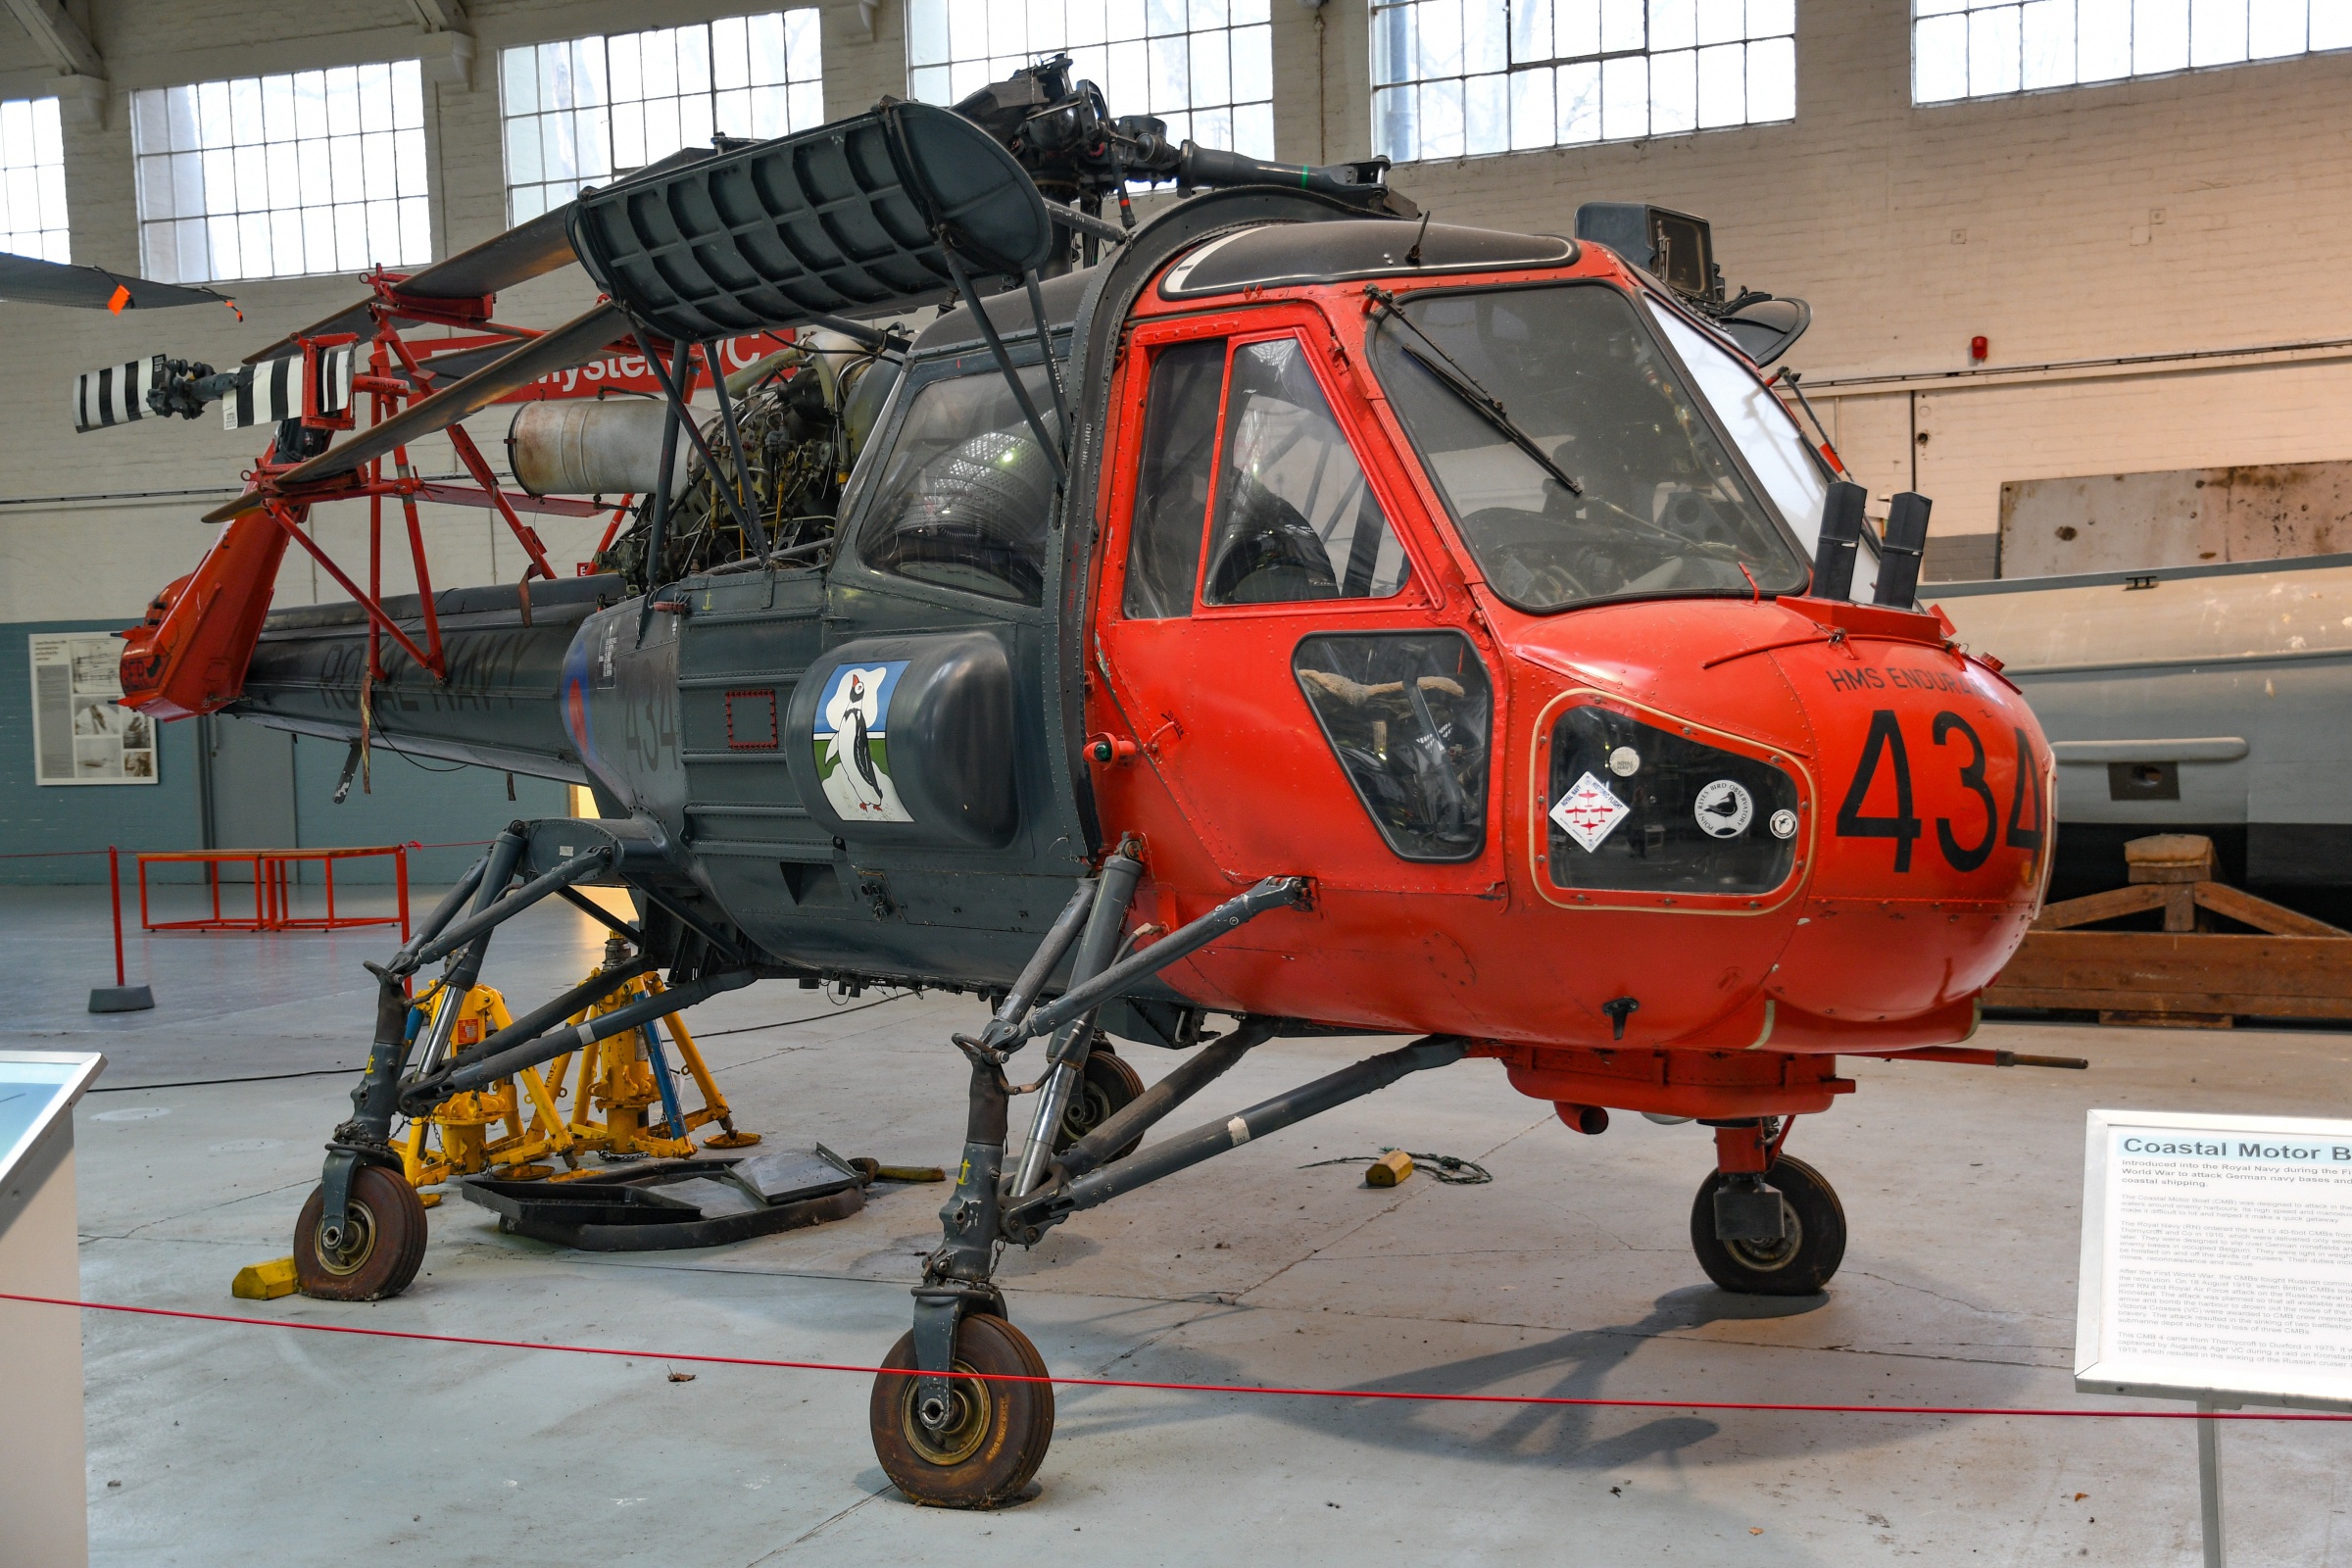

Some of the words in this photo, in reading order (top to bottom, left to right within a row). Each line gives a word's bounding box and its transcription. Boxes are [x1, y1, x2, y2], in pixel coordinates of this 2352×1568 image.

[320, 639, 420, 712] ROAL
[1826, 667, 1886, 693] HMS
[625, 652, 678, 772] 434
[1592, 781, 1610, 799] HISTORIC
[1607, 795, 1624, 810] FLIGHT
[1709, 782, 1727, 792] BIRD
[1836, 710, 2045, 884] 434
[1560, 793, 1574, 808] ROYAL
[1697, 790, 1709, 809] REYES
[1729, 784, 1748, 826] OBSERVATORY
[1698, 812, 1714, 831] POINT
[2123, 1137, 2227, 1156] Coastal
[2237, 1142, 2322, 1160] Motor
[2121, 1167, 2151, 1176] World
[2190, 1170, 2222, 1179] attack
[2225, 1171, 2267, 1180] German
[2122, 1159, 2177, 1168] Introduced
[2221, 1163, 2251, 1172] Royal
[2253, 1164, 2280, 1173] Navy
[2282, 1165, 2318, 1175] during
[2160, 1178, 2209, 1188] shipping.
